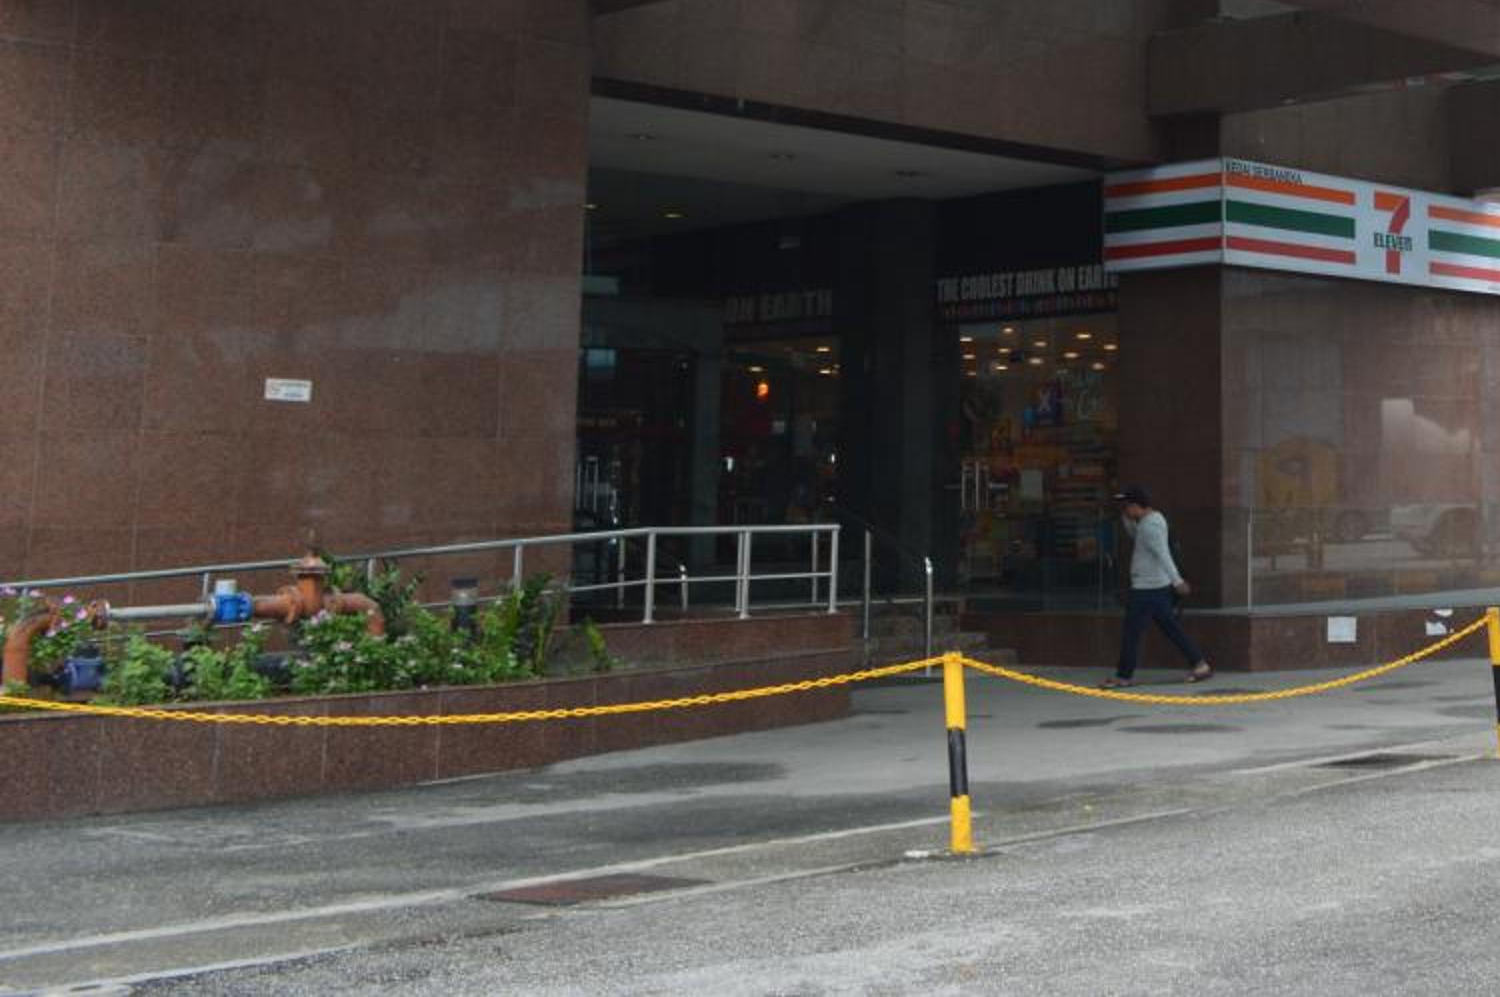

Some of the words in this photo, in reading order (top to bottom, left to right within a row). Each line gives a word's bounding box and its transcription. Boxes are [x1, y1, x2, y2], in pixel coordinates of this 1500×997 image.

[1374, 190, 1411, 275] 7
[936, 277, 960, 302] THE
[960, 272, 1012, 300] COOLEST
[1015, 267, 1057, 296] DRINK
[1057, 266, 1076, 293] ON
